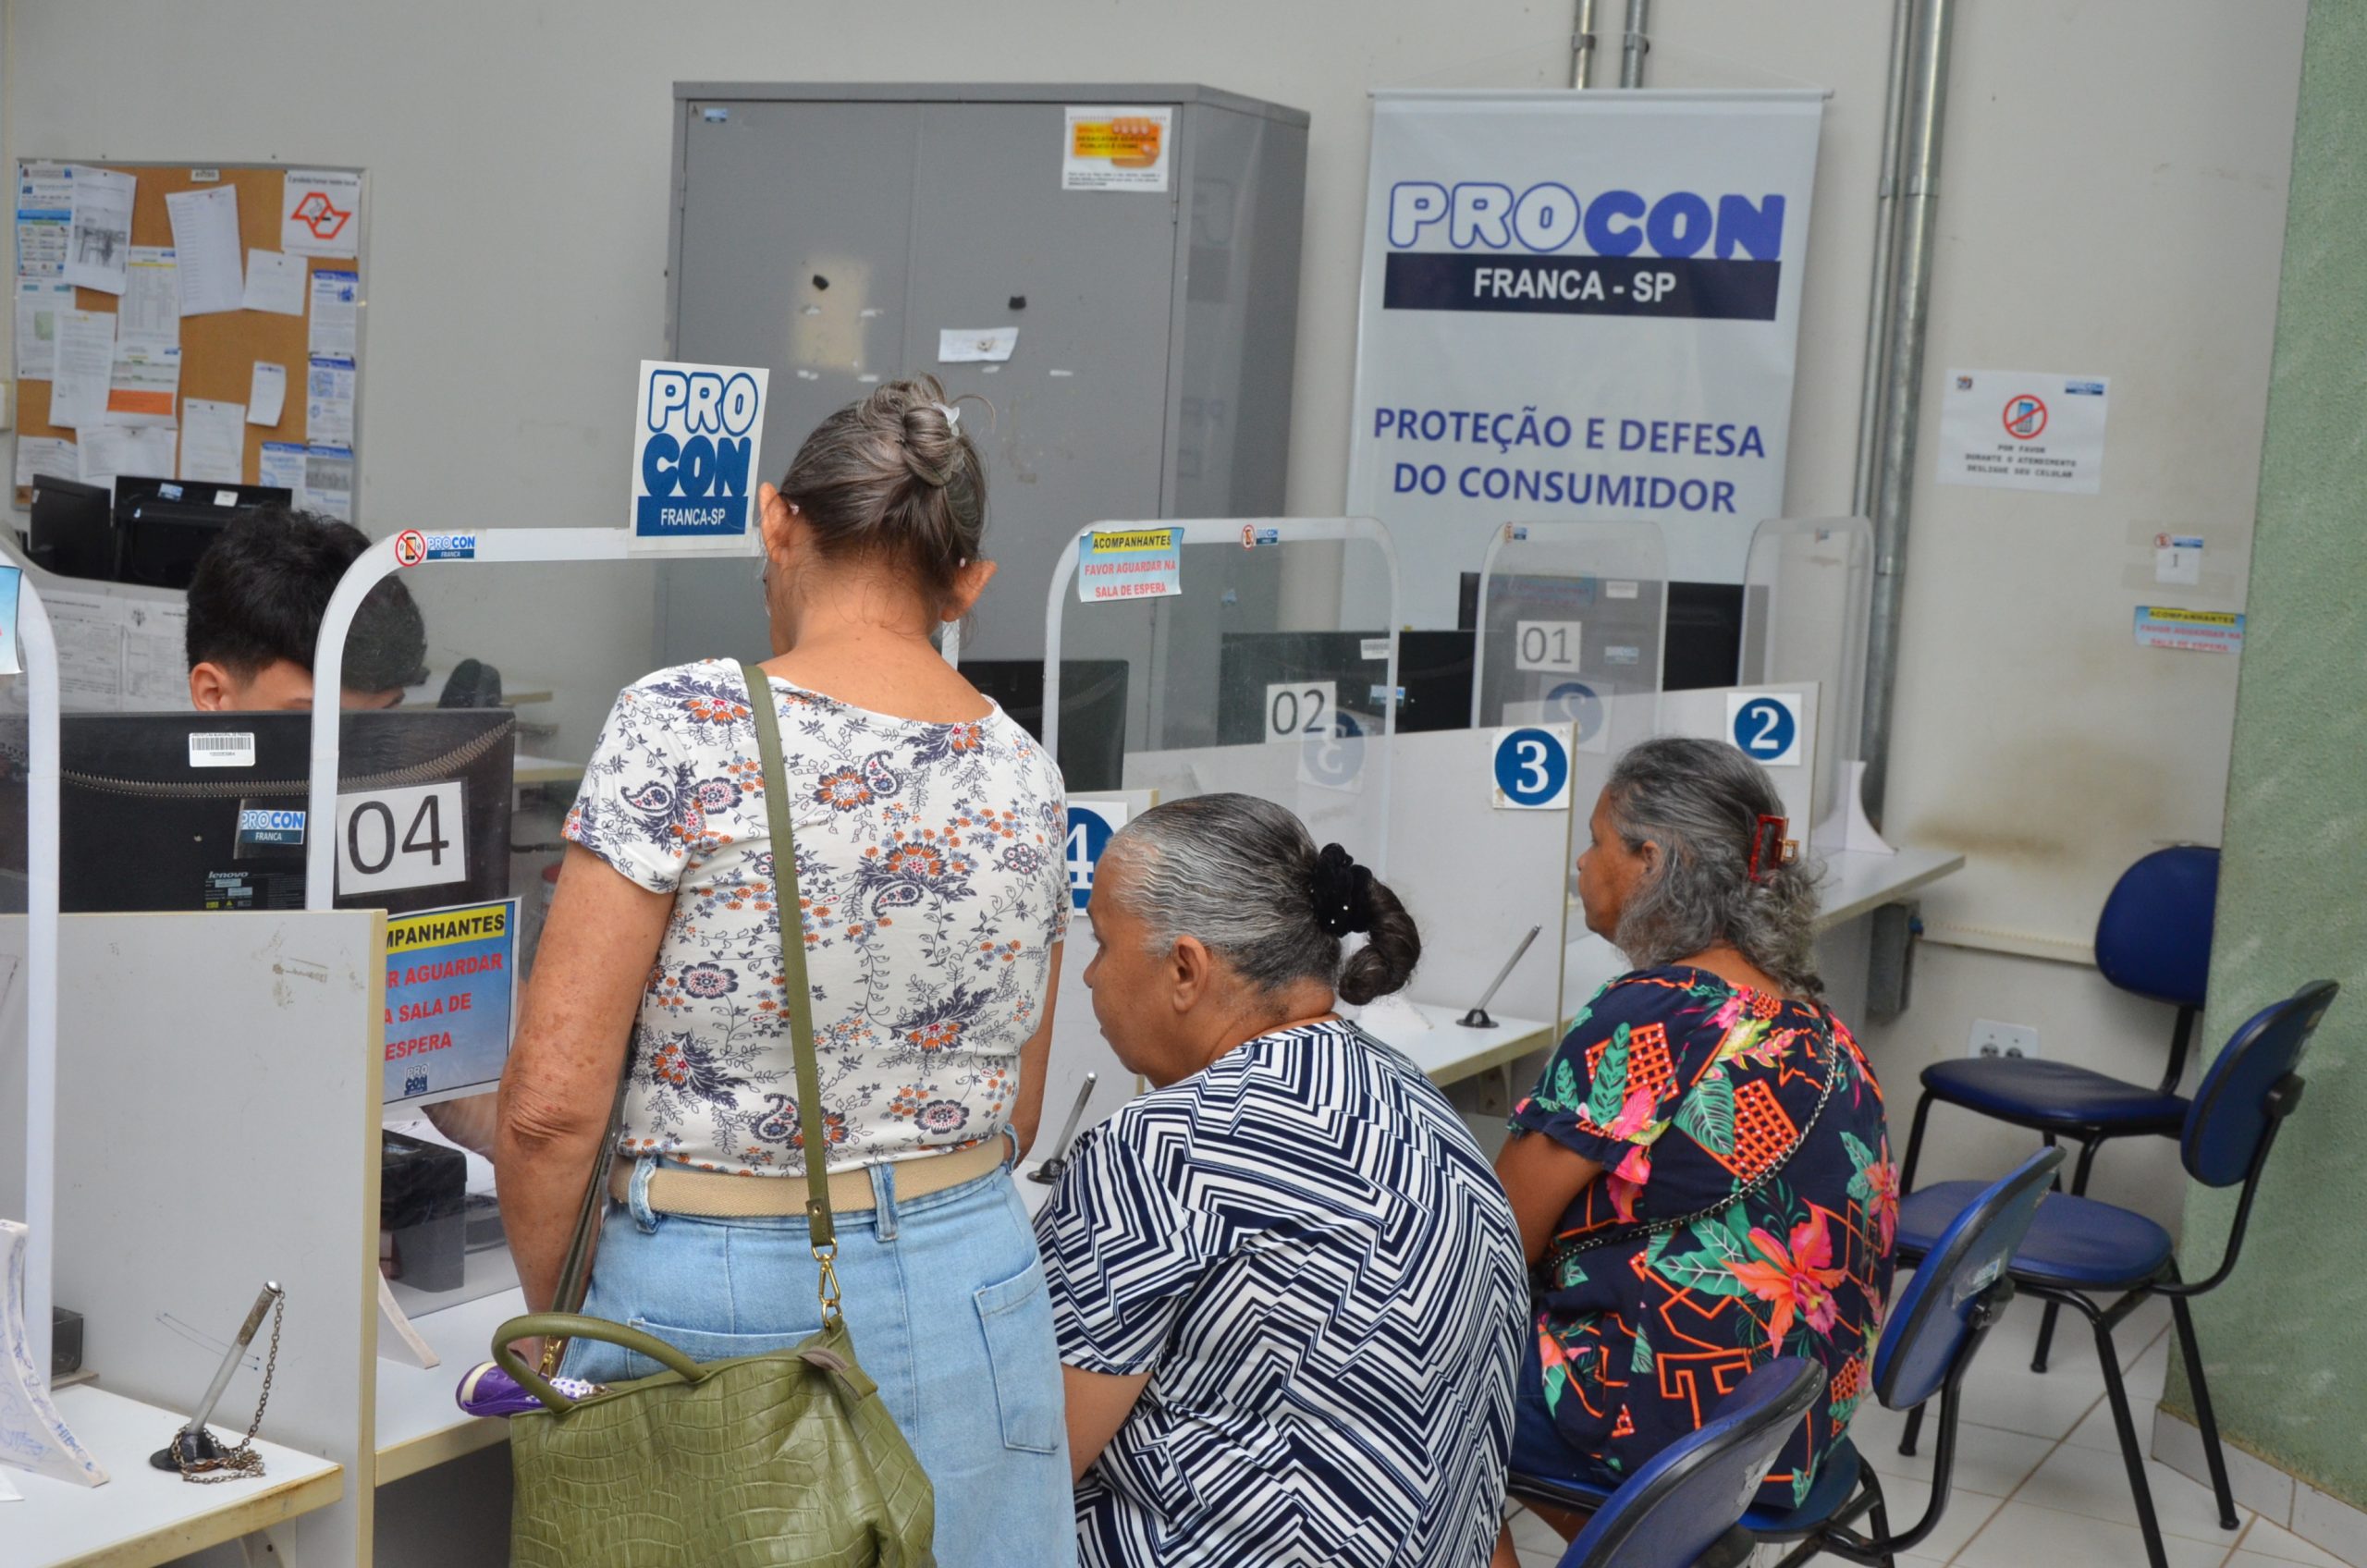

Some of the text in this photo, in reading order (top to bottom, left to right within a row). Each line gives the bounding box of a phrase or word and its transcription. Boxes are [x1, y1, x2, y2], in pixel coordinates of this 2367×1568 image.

[1388, 181, 1785, 262] PROCON
[1474, 267, 1605, 301] FRANCA
[1632, 272, 1676, 302] SP
[647, 369, 759, 437] PRO
[1373, 405, 1766, 459] PROTEÇÃO E DEFESA
[642, 433, 753, 496] CON
[1393, 462, 1736, 514] DO CONSUMIDOR
[660, 508, 726, 526] FRANCA-SP
[427, 535, 475, 550] PROCON
[1093, 534, 1171, 550] ACOMPANHANTES
[1085, 559, 1176, 577] FAVOR AGUARDAR NA
[1095, 582, 1167, 598] SALA DE ESPERA
[1521, 626, 1572, 664] 01
[1271, 688, 1326, 735] 02
[1749, 706, 1779, 750] 2
[1515, 740, 1550, 794] 3
[241, 811, 304, 829] PROCON
[255, 832, 282, 841] FRANCA
[348, 794, 449, 875] 04
[1066, 824, 1094, 889] 4
[208, 871, 249, 879] lenovo
[404, 953, 503, 986] AGUARDAR
[399, 998, 443, 1023] SALA
[448, 992, 472, 1012] DE
[385, 1031, 452, 1061] ESPERA
